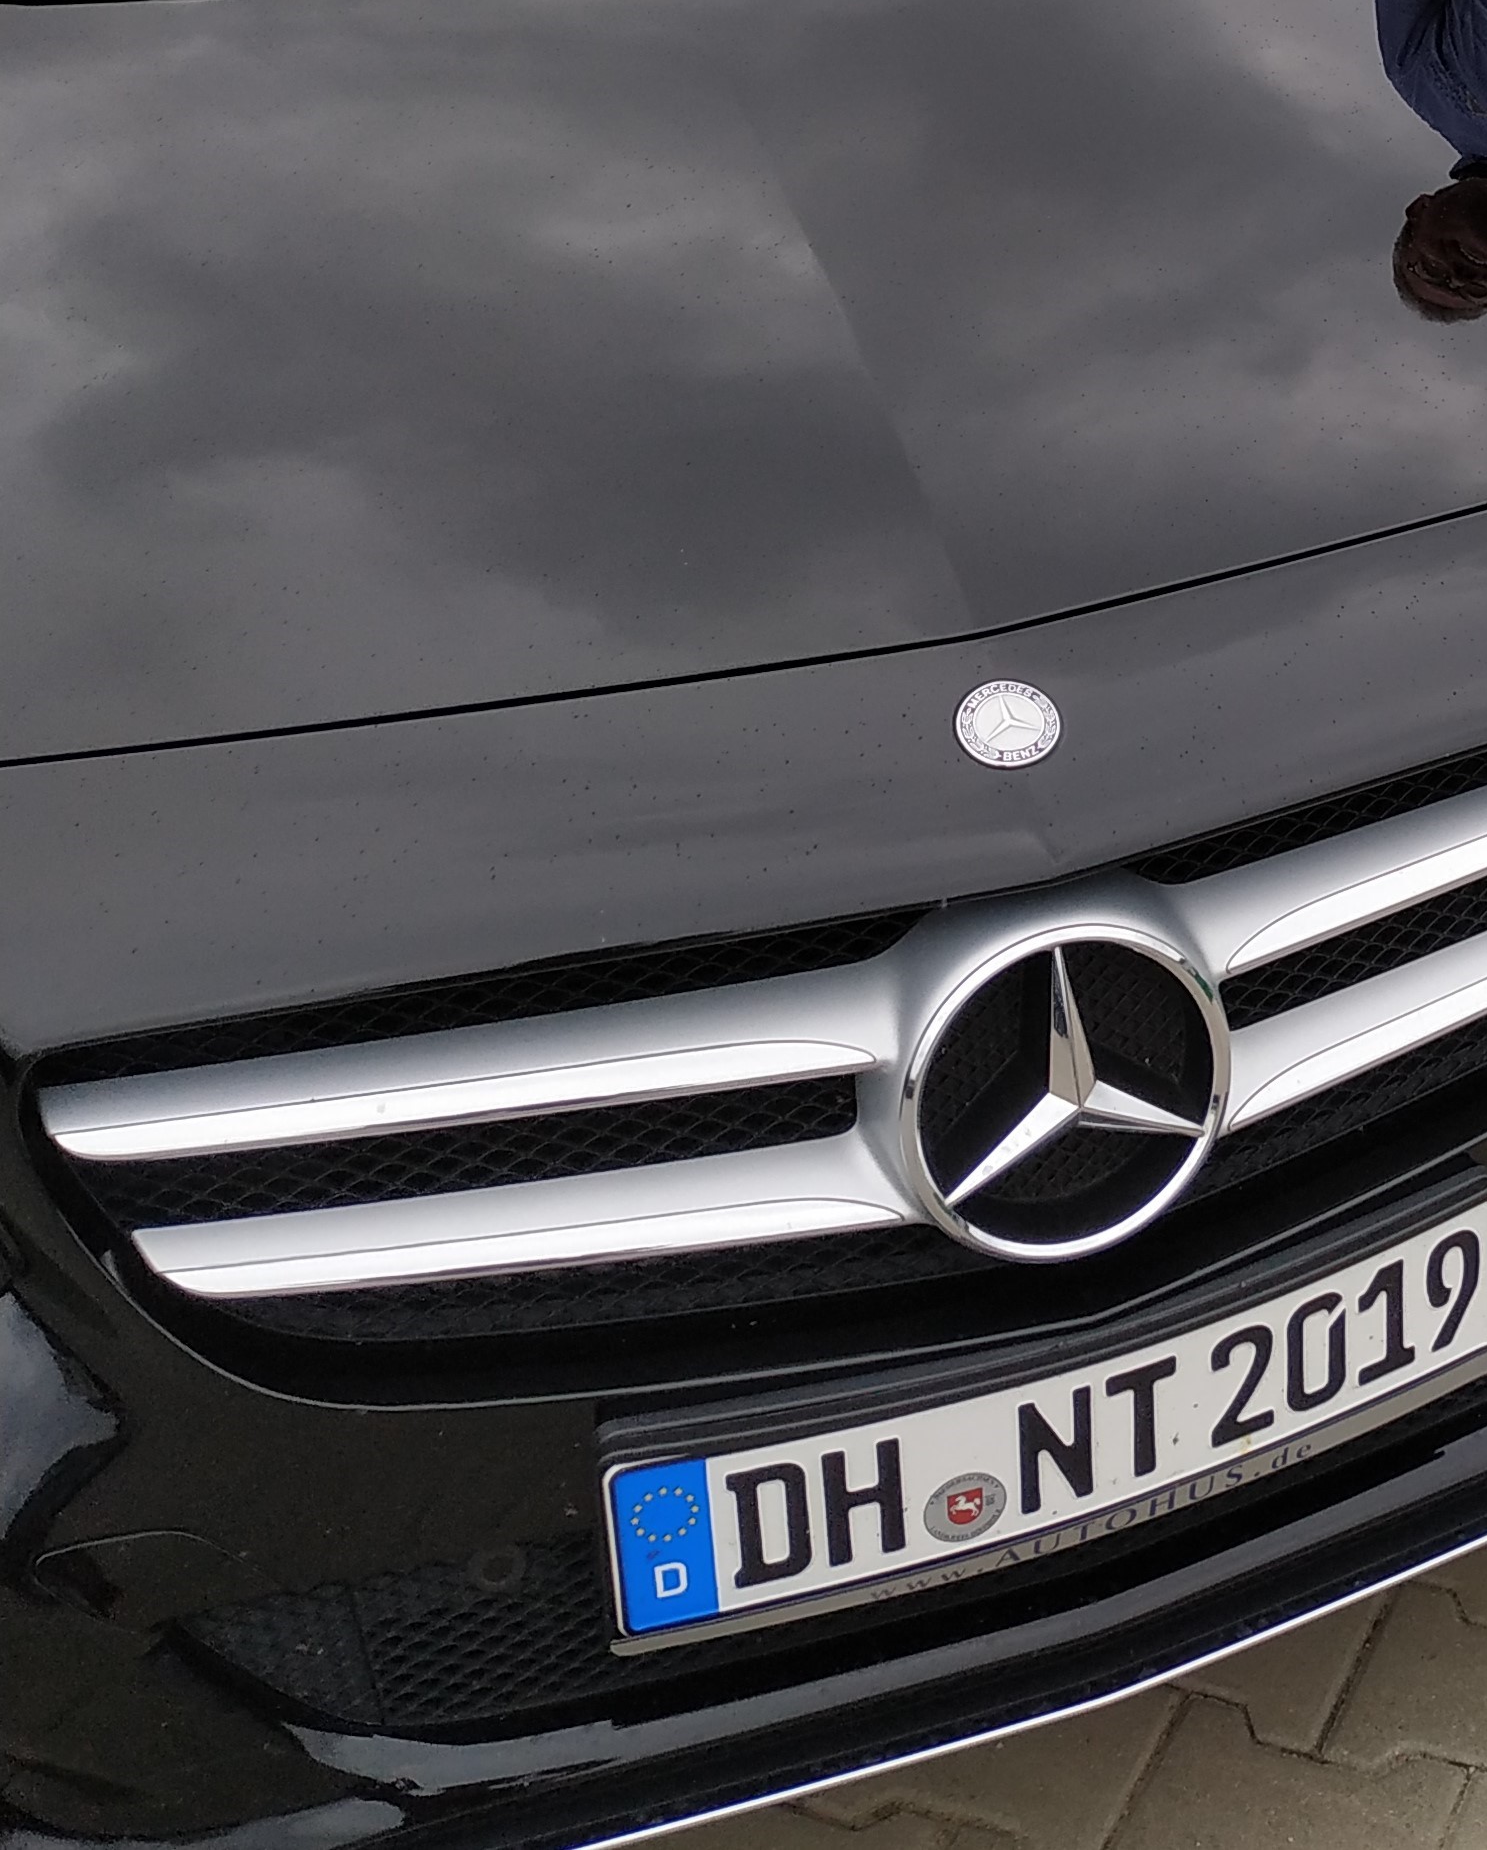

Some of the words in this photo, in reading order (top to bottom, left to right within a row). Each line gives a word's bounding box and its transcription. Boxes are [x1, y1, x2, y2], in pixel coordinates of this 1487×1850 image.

[966, 683, 1032, 709] MERCEDES
[1002, 745, 1040, 762] BENZ
[725, 1436, 907, 1589] DH
[1017, 1354, 1177, 1515] NT
[1210, 1228, 1481, 1448] 2019
[869, 1443, 1313, 1600] www.AUTOHUS.de
[653, 1561, 689, 1599] D
